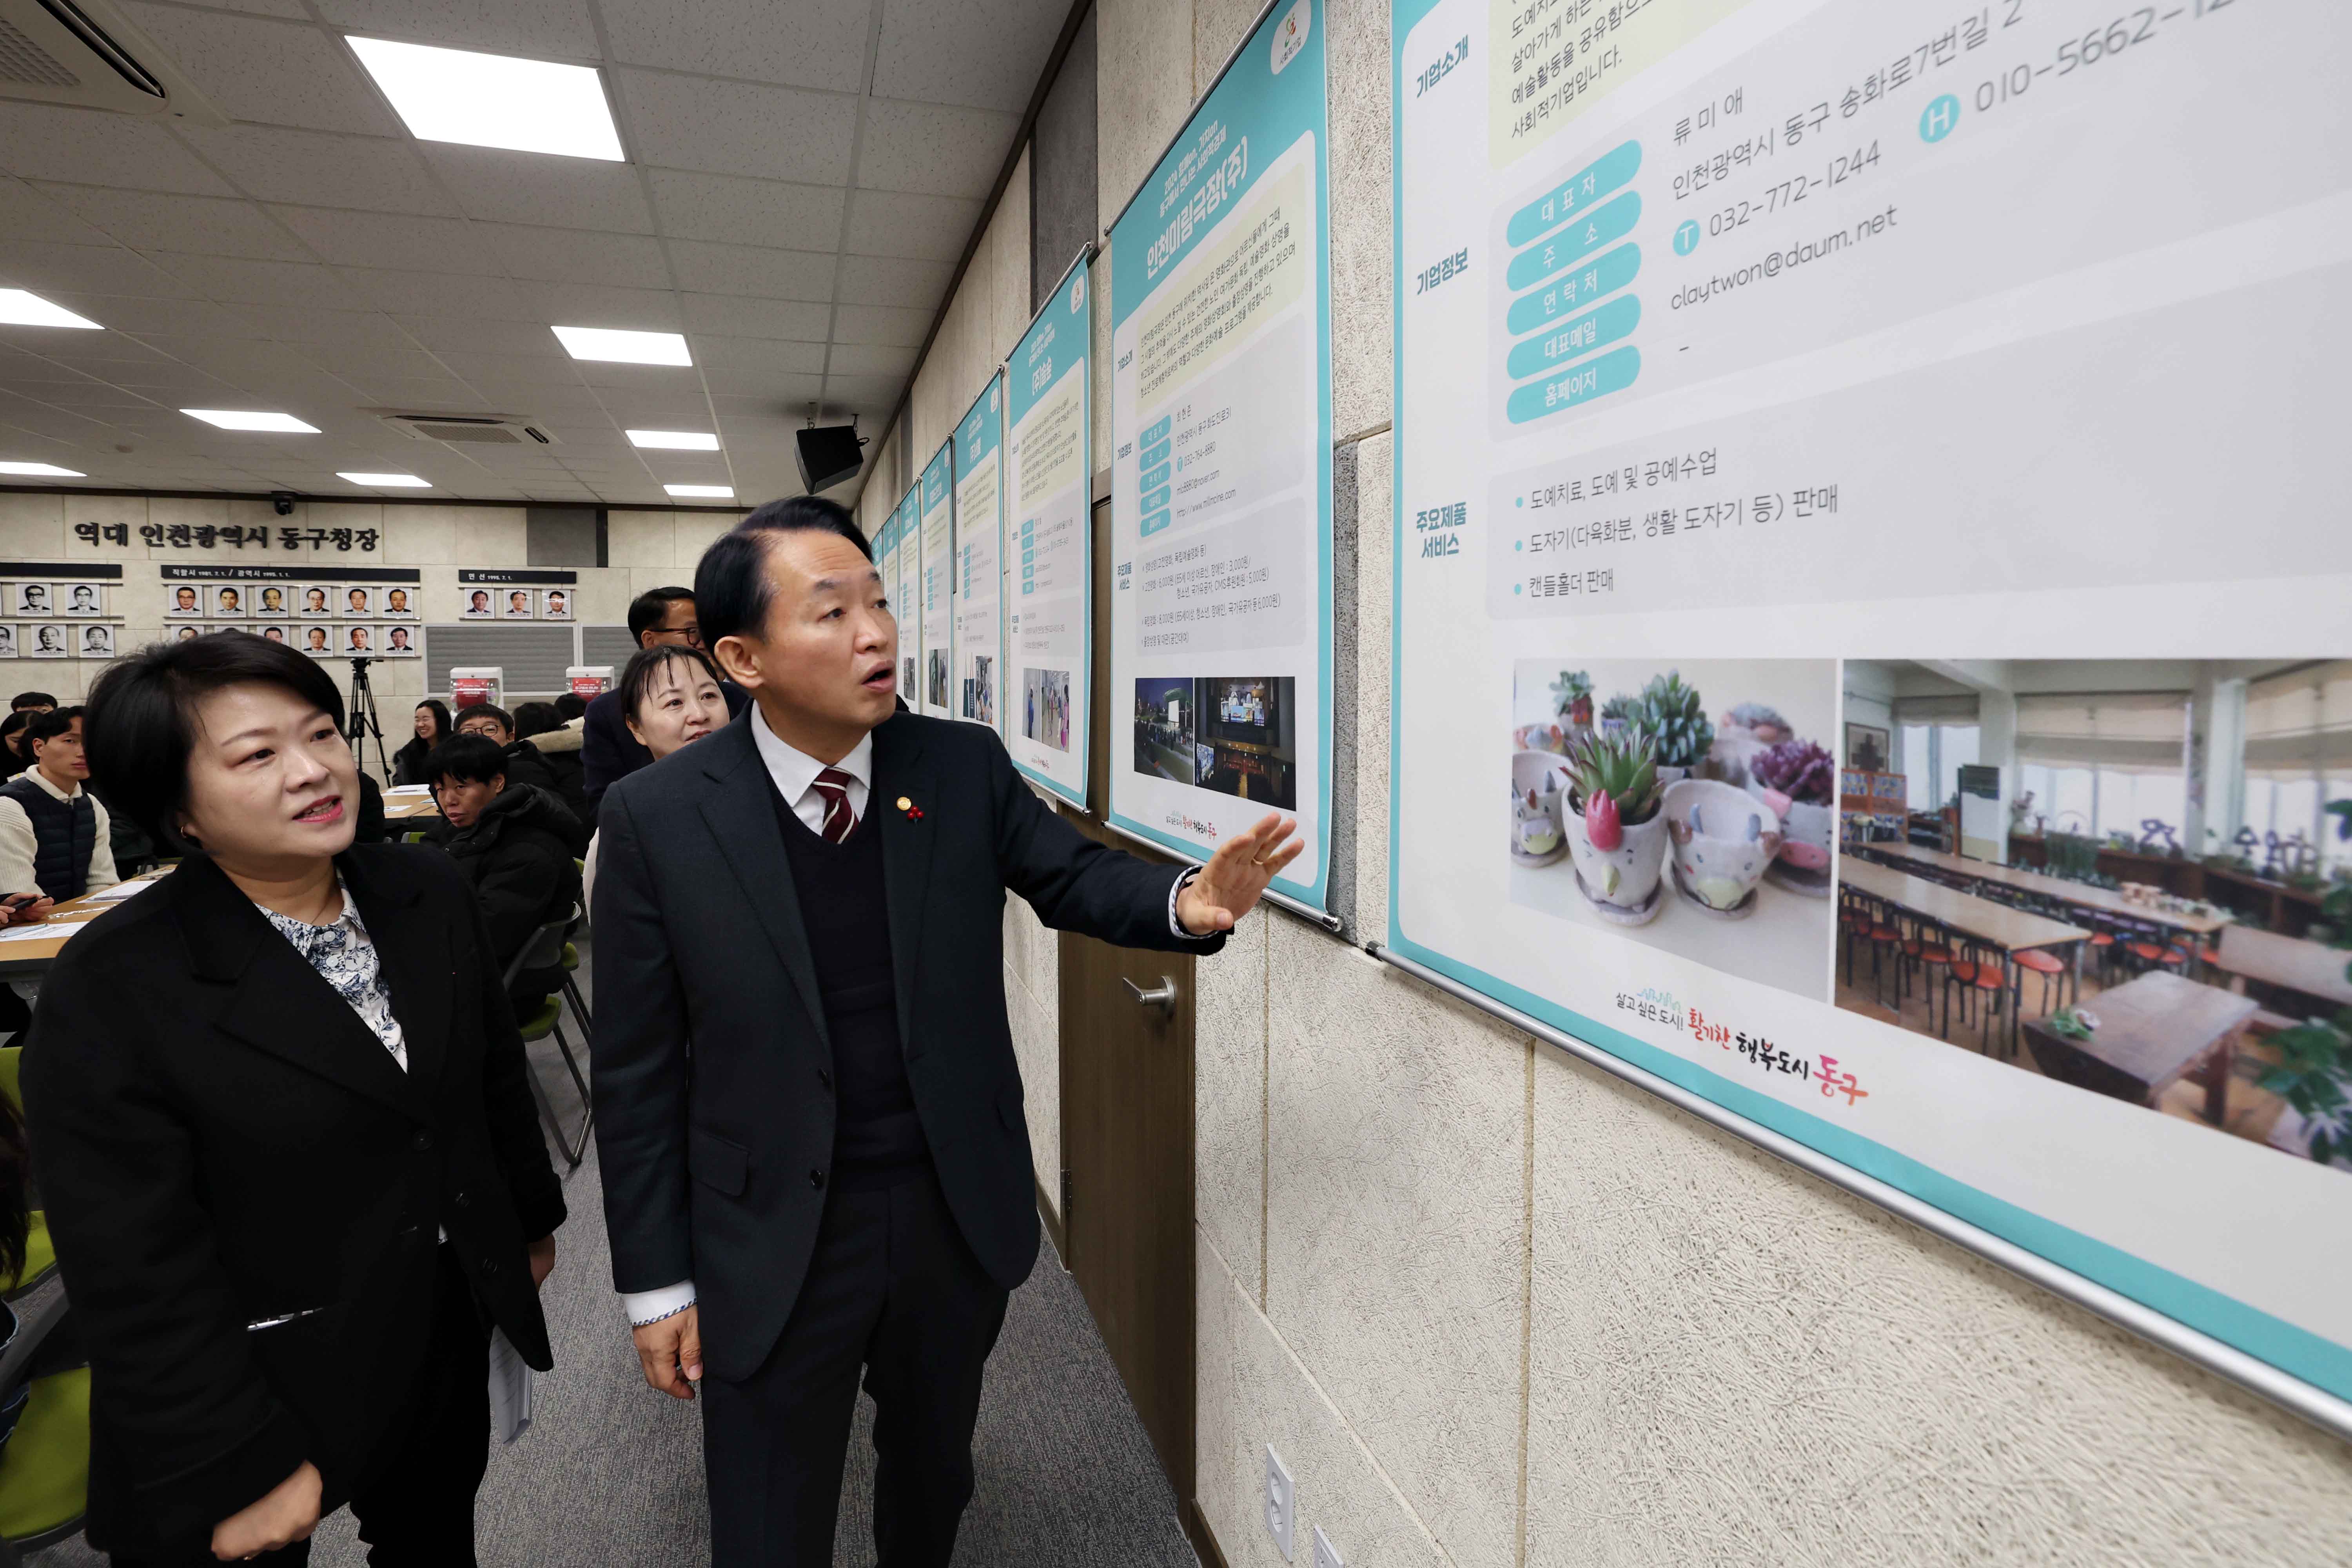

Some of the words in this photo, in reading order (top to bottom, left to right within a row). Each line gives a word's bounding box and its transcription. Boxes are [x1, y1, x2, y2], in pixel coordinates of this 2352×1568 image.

[1279, 34, 1301, 66] 사회적기업
[1416, 34, 1468, 98] 기업소개
[1512, 15, 1561, 73] 살아가게
[1512, 42, 1574, 104] 예술활동을
[1580, 0, 1651, 53] 공유함으
[1512, 44, 1622, 138] 사회적기업입니다.
[1673, 128, 1774, 200] 인천광역시
[1784, 102, 1830, 146] 동구
[1840, 7, 1988, 119] 송화로7번길
[1674, 117, 1692, 146] 류
[1699, 102, 1715, 130] 미
[1725, 87, 1742, 115] 애
[1679, 225, 1693, 250] T
[1710, 139, 1881, 236] 032-772-1244
[1928, 102, 1949, 136] H
[1148, 136, 1247, 279] 인천미림극장(주)
[1216, 250, 1239, 279] 영화관으로
[1240, 219, 1267, 256] 어르신들에게
[1269, 207, 1279, 227] 그때
[1250, 240, 1270, 266] 예술영화
[1271, 223, 1290, 248] 상영을
[1254, 259, 1274, 286] 진행하고
[1276, 241, 1295, 267] 있으며
[1417, 247, 1468, 295] 기업정보
[1672, 205, 1897, 309] claytwon@daum.net
[1205, 326, 1223, 348] 문화예술
[1225, 306, 1246, 334] 프로그램을
[1247, 283, 1272, 313] 제공합니다.
[1545, 318, 1596, 358] 대표메일
[1545, 367, 1596, 407] 홈페이지
[1177, 426, 1198, 446] 인천광역시
[1198, 421, 1206, 435] 동구
[1530, 483, 1585, 509] 도예치료,
[1592, 470, 1618, 497] 도예
[1624, 464, 1639, 490] 및
[1644, 448, 1717, 486] 공예수업
[75, 522, 128, 547] 역대
[140, 523, 268, 548] 인천광역시
[278, 527, 379, 552] 동구청장
[1416, 502, 1467, 534] 주요제품
[1422, 533, 1460, 558] 서비스
[1530, 515, 1636, 552] 도자기(다육화분,
[1642, 508, 1677, 538] 생활
[1684, 499, 1743, 530] 도자기
[1751, 494, 1783, 523] 등)
[1793, 484, 1838, 518] 판매
[1529, 572, 1583, 598] 캔들홀더
[1586, 568, 1614, 593] 판매
[1638, 1002, 1657, 1021] 싶은
[1659, 1011, 1683, 1031] 도시!
[1688, 1008, 1730, 1050] 활기찬
[1736, 1032, 1809, 1080] 행복도시
[1813, 1054, 1868, 1106] 동구
